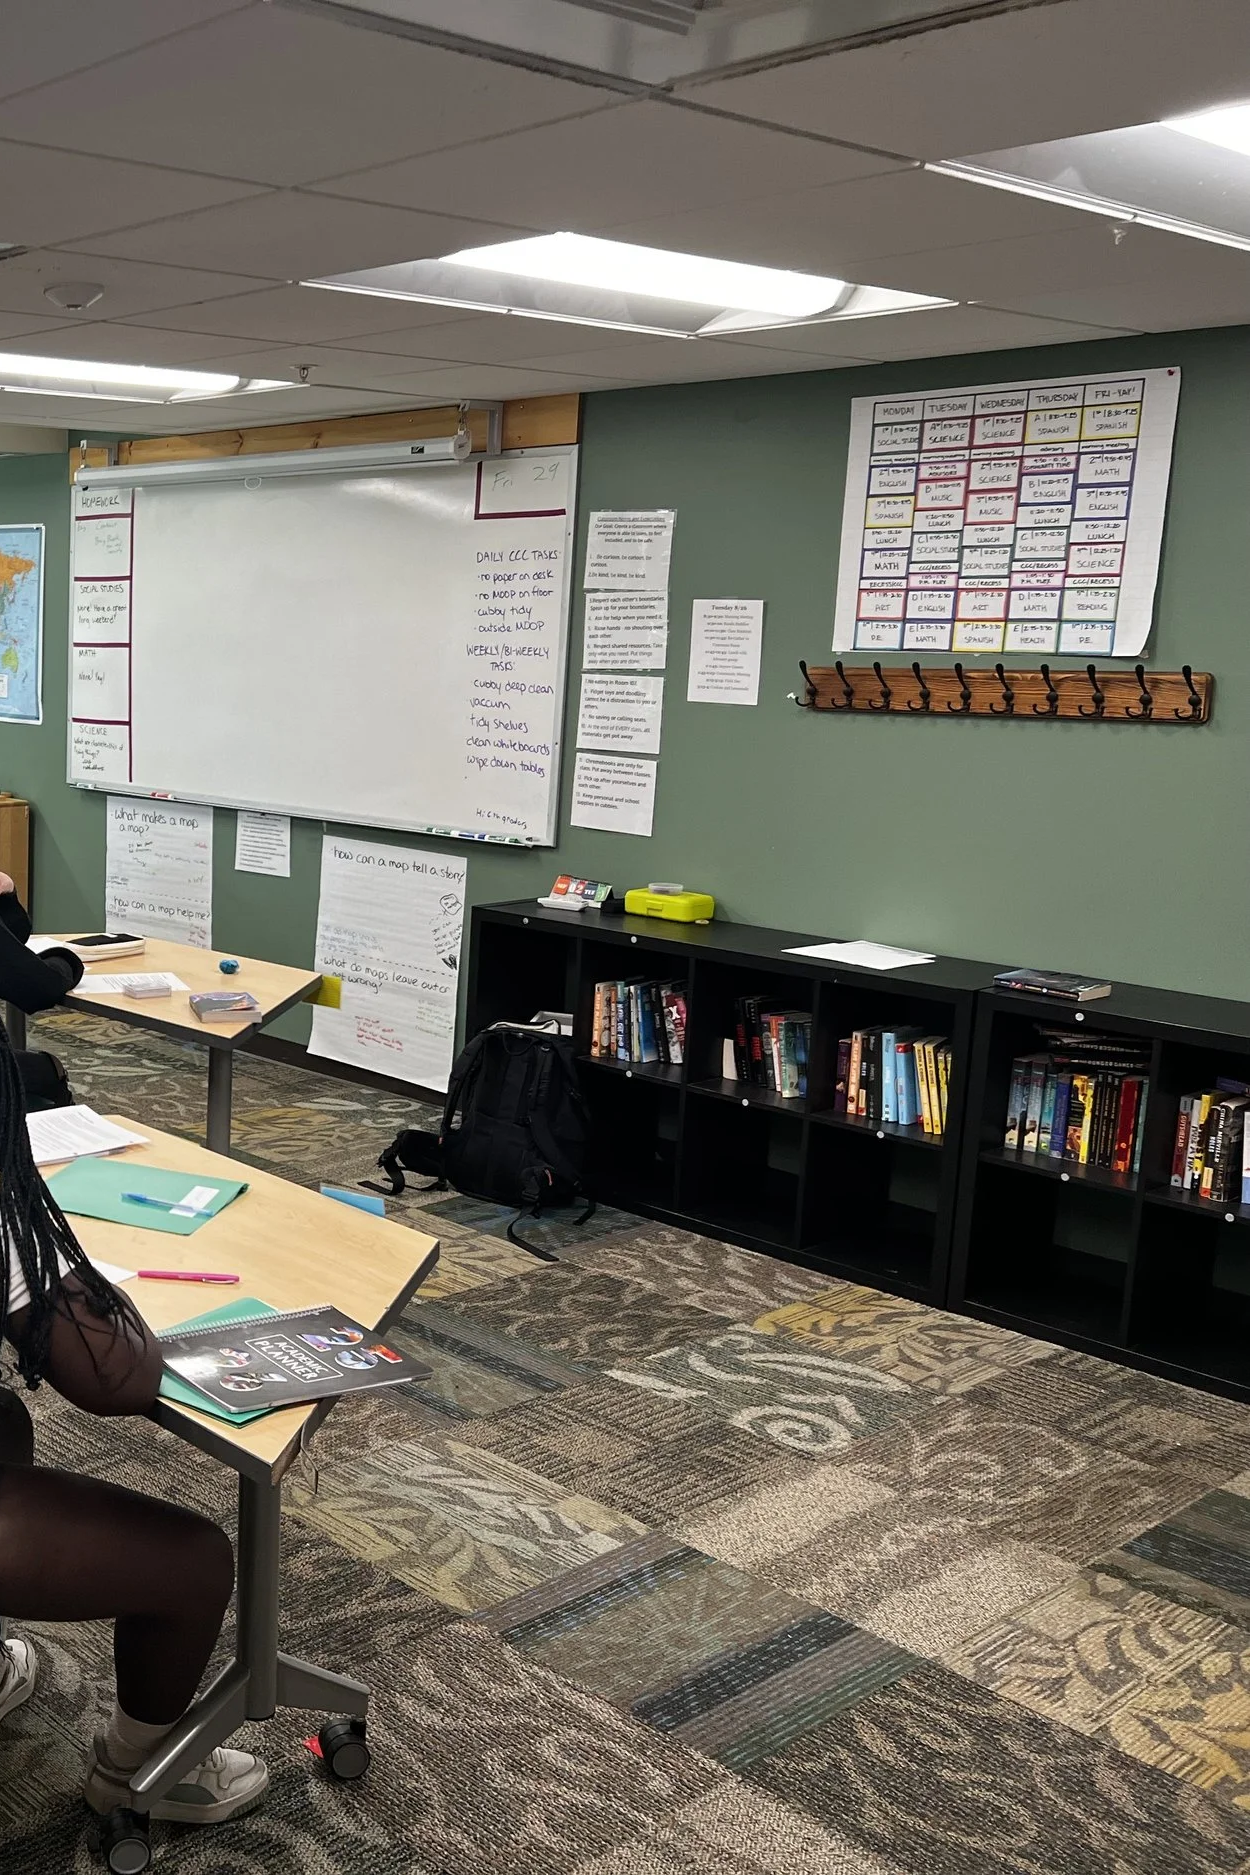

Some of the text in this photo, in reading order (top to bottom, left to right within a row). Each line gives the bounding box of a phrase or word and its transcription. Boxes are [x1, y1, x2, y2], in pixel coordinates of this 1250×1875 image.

[980, 398, 1025, 409] WEDNESDAY
[1036, 392, 1079, 404] THURSDAY
[883, 406, 915, 416] MONDAY
[929, 403, 968, 414] TUESDAY
[1038, 426, 1069, 436] SPANISH
[1095, 422, 1128, 431] SPANISH
[929, 433, 966, 445] SCIENCE
[982, 430, 1016, 441] SCIENCE
[533, 462, 560, 482] 29
[1094, 468, 1120, 476] MATH
[978, 474, 1012, 484] SCIENCE
[1033, 488, 1067, 498] ENGLISH
[81, 495, 120, 508] HOMEWORK
[1089, 503, 1119, 511] ENGLISH
[1034, 517, 1060, 525] LUNCH
[875, 537, 898, 545] LUNCH
[476, 551, 504, 563] DAILY
[509, 549, 529, 561] CCC
[874, 562, 899, 570] MATH
[1076, 560, 1116, 569] SCIENCE
[481, 573, 491, 581] no
[493, 573, 518, 585] paper
[532, 569, 554, 580] desk
[79, 583, 125, 594] SOCIAL STUDIES
[519, 590, 530, 598] on
[531, 585, 554, 597] floor
[478, 605, 533, 621] cubby tidy
[918, 604, 946, 613] ENGLISH
[1023, 604, 1048, 612] MATH
[478, 622, 512, 633] outside
[964, 636, 994, 644] SPANISH
[78, 649, 97, 658] MATH
[473, 679, 554, 695] cubby deep clean
[470, 714, 490, 732] tidy
[79, 725, 108, 736] SCIENCE
[466, 735, 550, 756] clean whiteboards
[490, 756, 517, 771] down
[519, 760, 545, 778] tables
[141, 811, 167, 824] makes
[169, 817, 177, 826] a
[179, 817, 199, 829] map
[119, 823, 150, 837] a map?
[333, 846, 353, 861] how
[356, 853, 375, 865] can
[378, 858, 387, 867] a
[388, 860, 410, 873] map
[413, 861, 428, 874] tell
[429, 867, 439, 876] a
[113, 896, 129, 907] how
[131, 900, 147, 911] can
[148, 903, 156, 913] a
[158, 906, 175, 918] map
[176, 907, 194, 919] help
[195, 911, 210, 920] me?
[350, 960, 362, 973] do
[365, 967, 389, 981] maps
[392, 971, 418, 987] leave
[421, 981, 438, 991] out
[347, 975, 383, 994] wrong?
[254, 1340, 318, 1380] PLANNER
[274, 1341, 329, 1374] ACADEMIC
